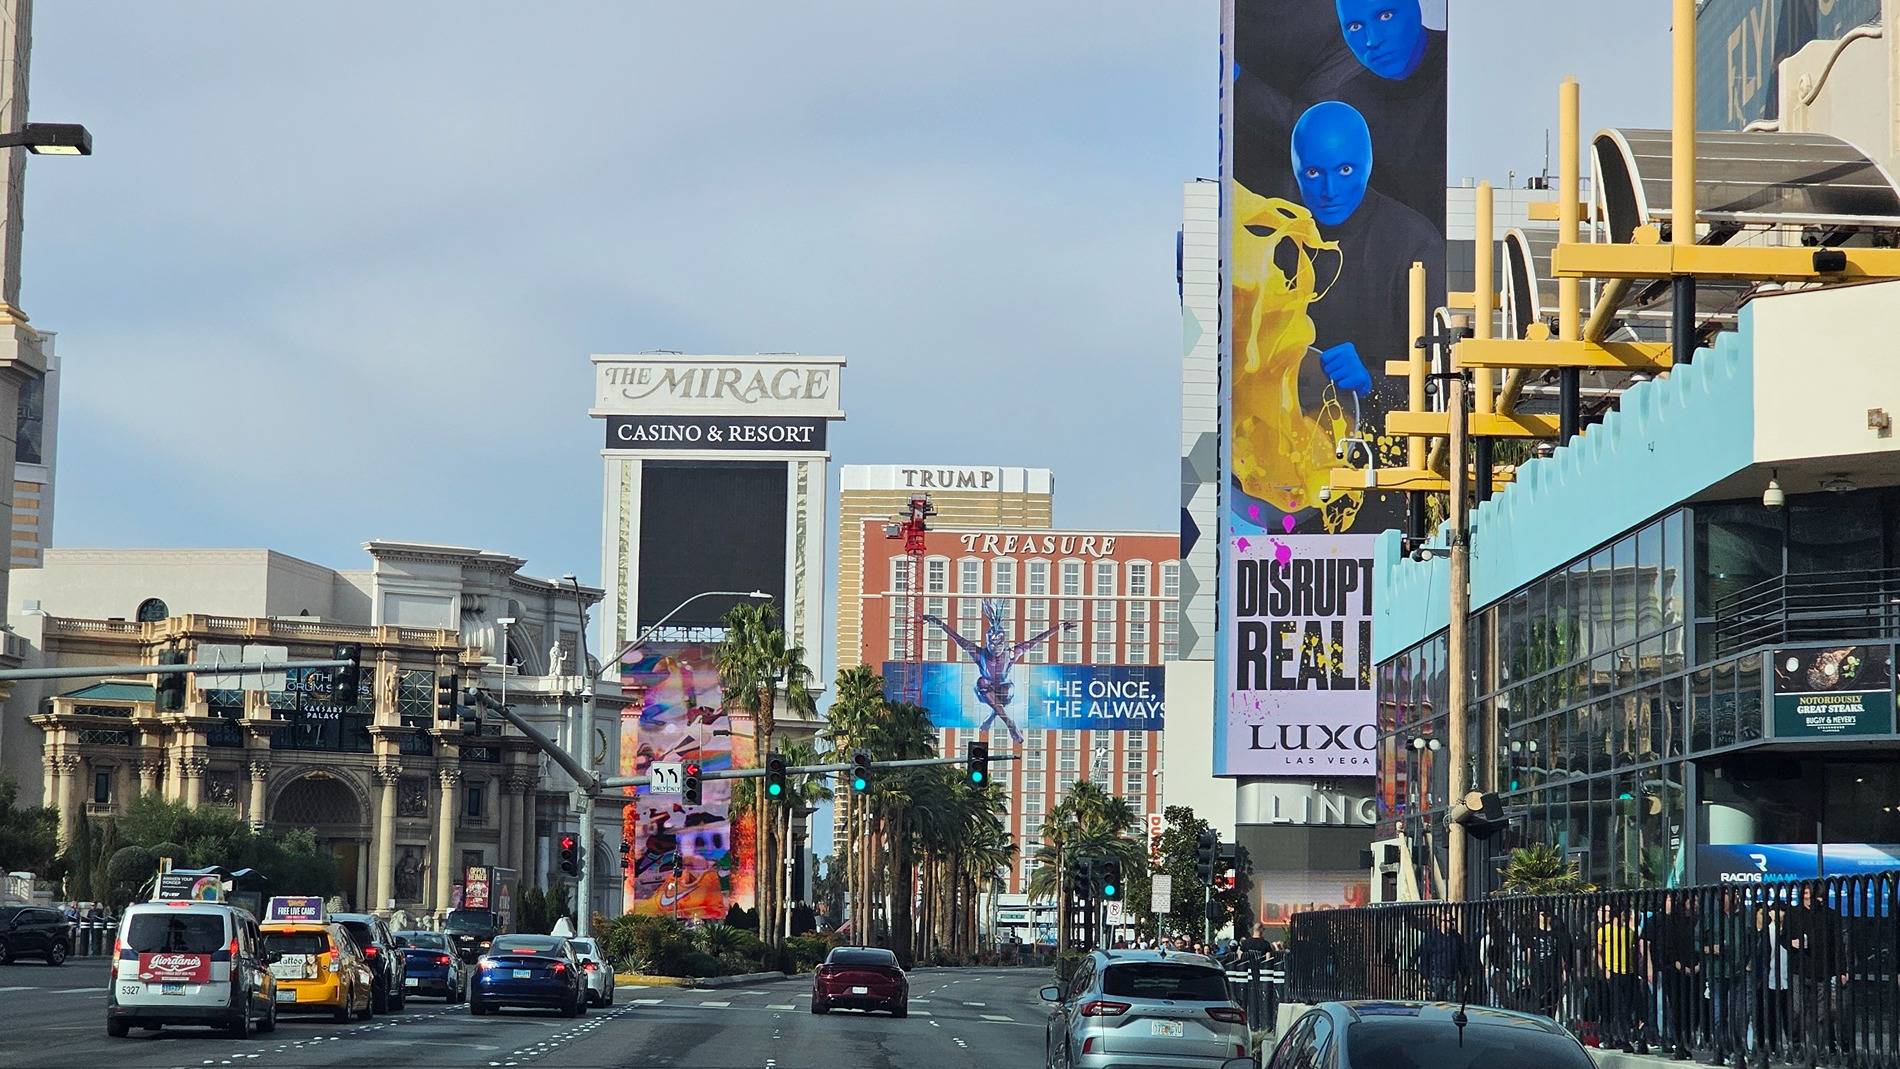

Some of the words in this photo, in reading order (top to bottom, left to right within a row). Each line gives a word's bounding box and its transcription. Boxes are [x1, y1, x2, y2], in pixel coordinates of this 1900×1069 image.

[605, 367, 652, 386] THE
[622, 367, 831, 404] MIRAGE
[617, 424, 702, 442] CASINO
[706, 425, 724, 442] &
[728, 425, 815, 443] RESORT
[901, 469, 994, 489] TRUMP
[960, 533, 1117, 558] TREASURE
[1236, 558, 1375, 617] DISRUPT
[287, 682, 322, 692] ORUM
[1042, 680, 1083, 698] THE
[1088, 680, 1157, 702] ONCE,
[1799, 695, 1863, 705] NOTORIOUSLY
[1042, 700, 1082, 718] THE
[1796, 705, 1827, 714] GREAT
[1828, 704, 1866, 713] STEAKS.
[307, 712, 340, 720] PALACE
[1285, 756, 1314, 765] LAS
[1720, 872, 1763, 882] RACING
[277, 907, 290, 915] FREE
[290, 907, 300, 915] LIVE
[282, 957, 303, 965] attoo
[122, 986, 140, 995] 5327
